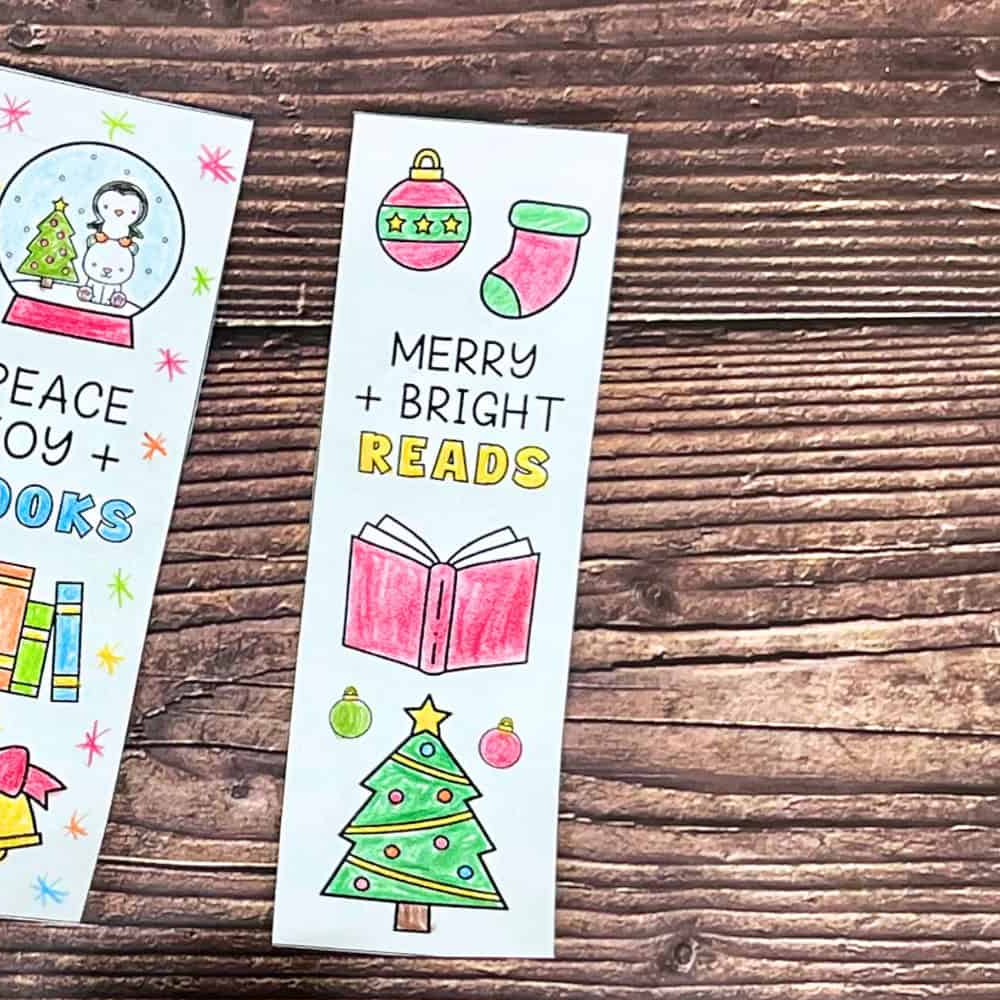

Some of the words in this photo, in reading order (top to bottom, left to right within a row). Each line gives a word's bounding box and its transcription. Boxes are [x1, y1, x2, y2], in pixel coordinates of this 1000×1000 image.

[390, 330, 538, 380] MERRY
[399, 382, 567, 433] BRIGHT
[357, 430, 551, 491] READS
